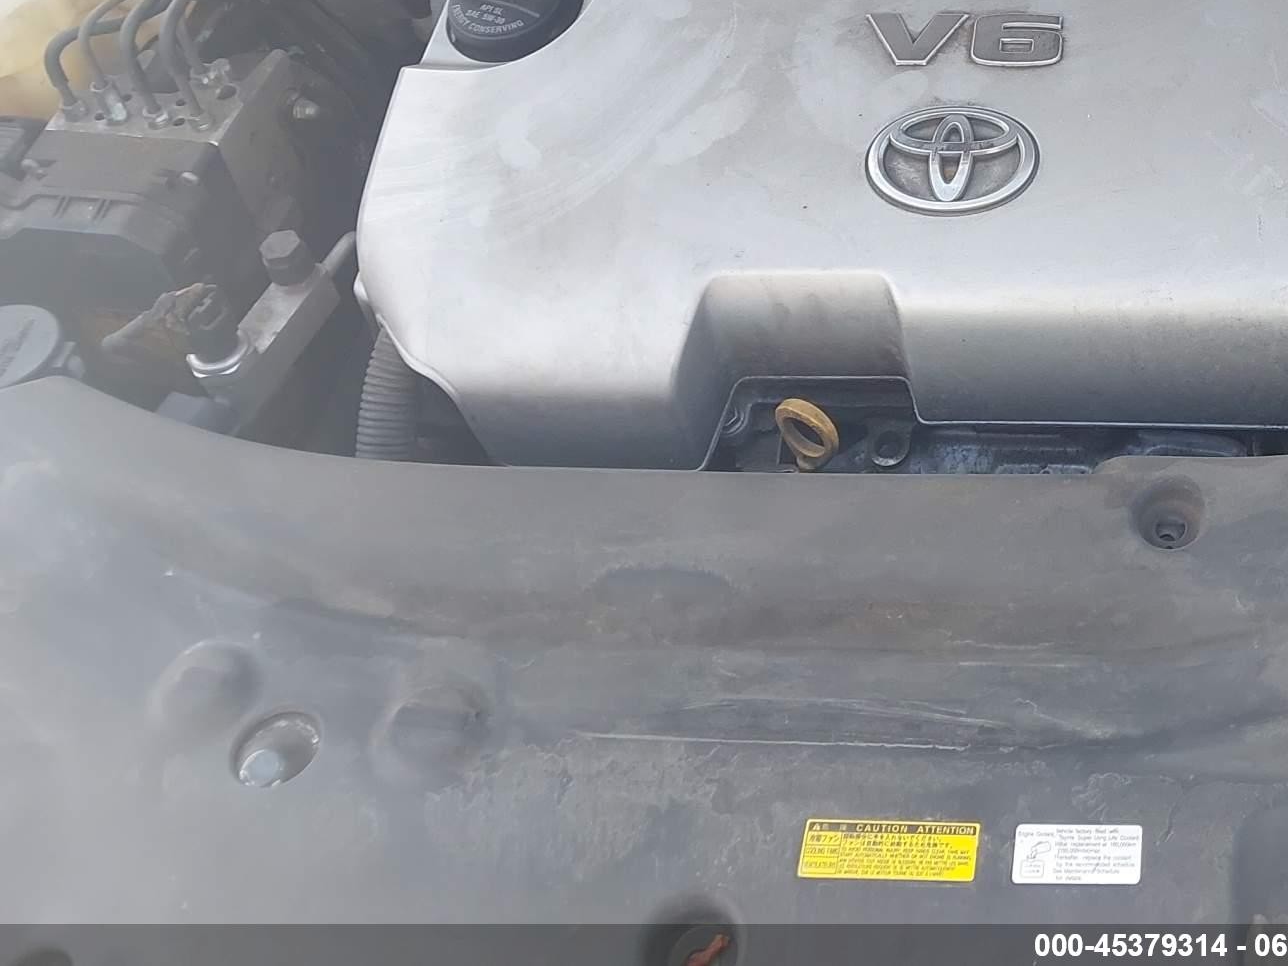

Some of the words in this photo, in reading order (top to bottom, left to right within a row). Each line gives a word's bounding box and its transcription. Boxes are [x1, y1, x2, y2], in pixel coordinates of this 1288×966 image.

[867, 11, 1065, 68] V6
[856, 823, 908, 833] CAUTION
[917, 825, 974, 835] ATTENTION
